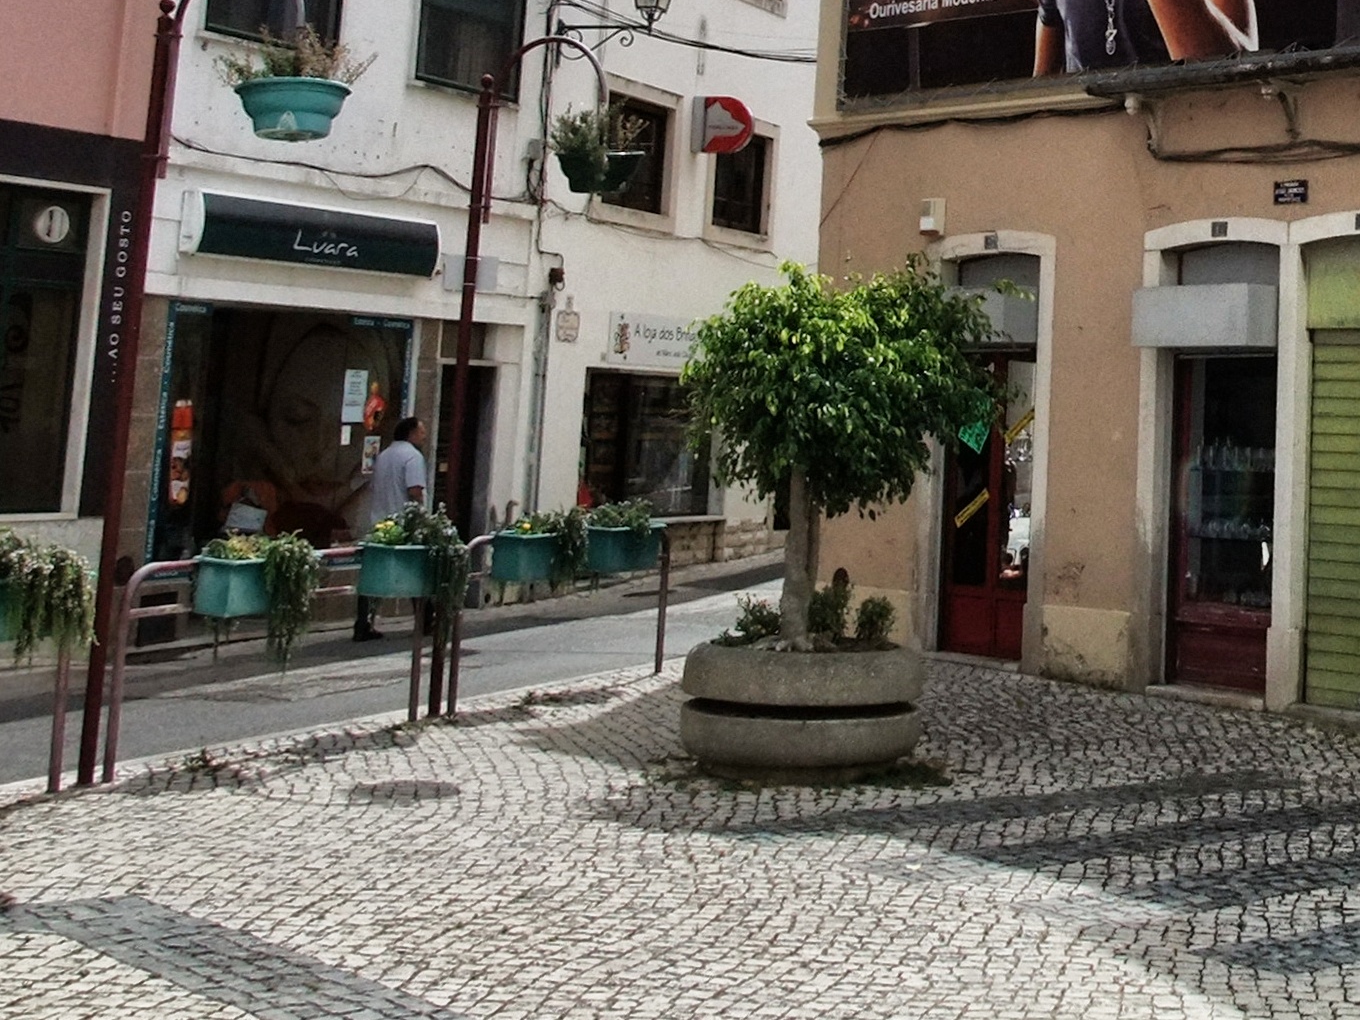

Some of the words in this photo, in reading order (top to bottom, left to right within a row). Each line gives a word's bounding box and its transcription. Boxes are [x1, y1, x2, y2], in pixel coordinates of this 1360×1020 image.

[115, 210, 132, 278] GOSTO
[111, 286, 125, 325] SEU
[634, 323, 641, 338] A
[643, 324, 657, 344] loja
[659, 326, 674, 341] dos
